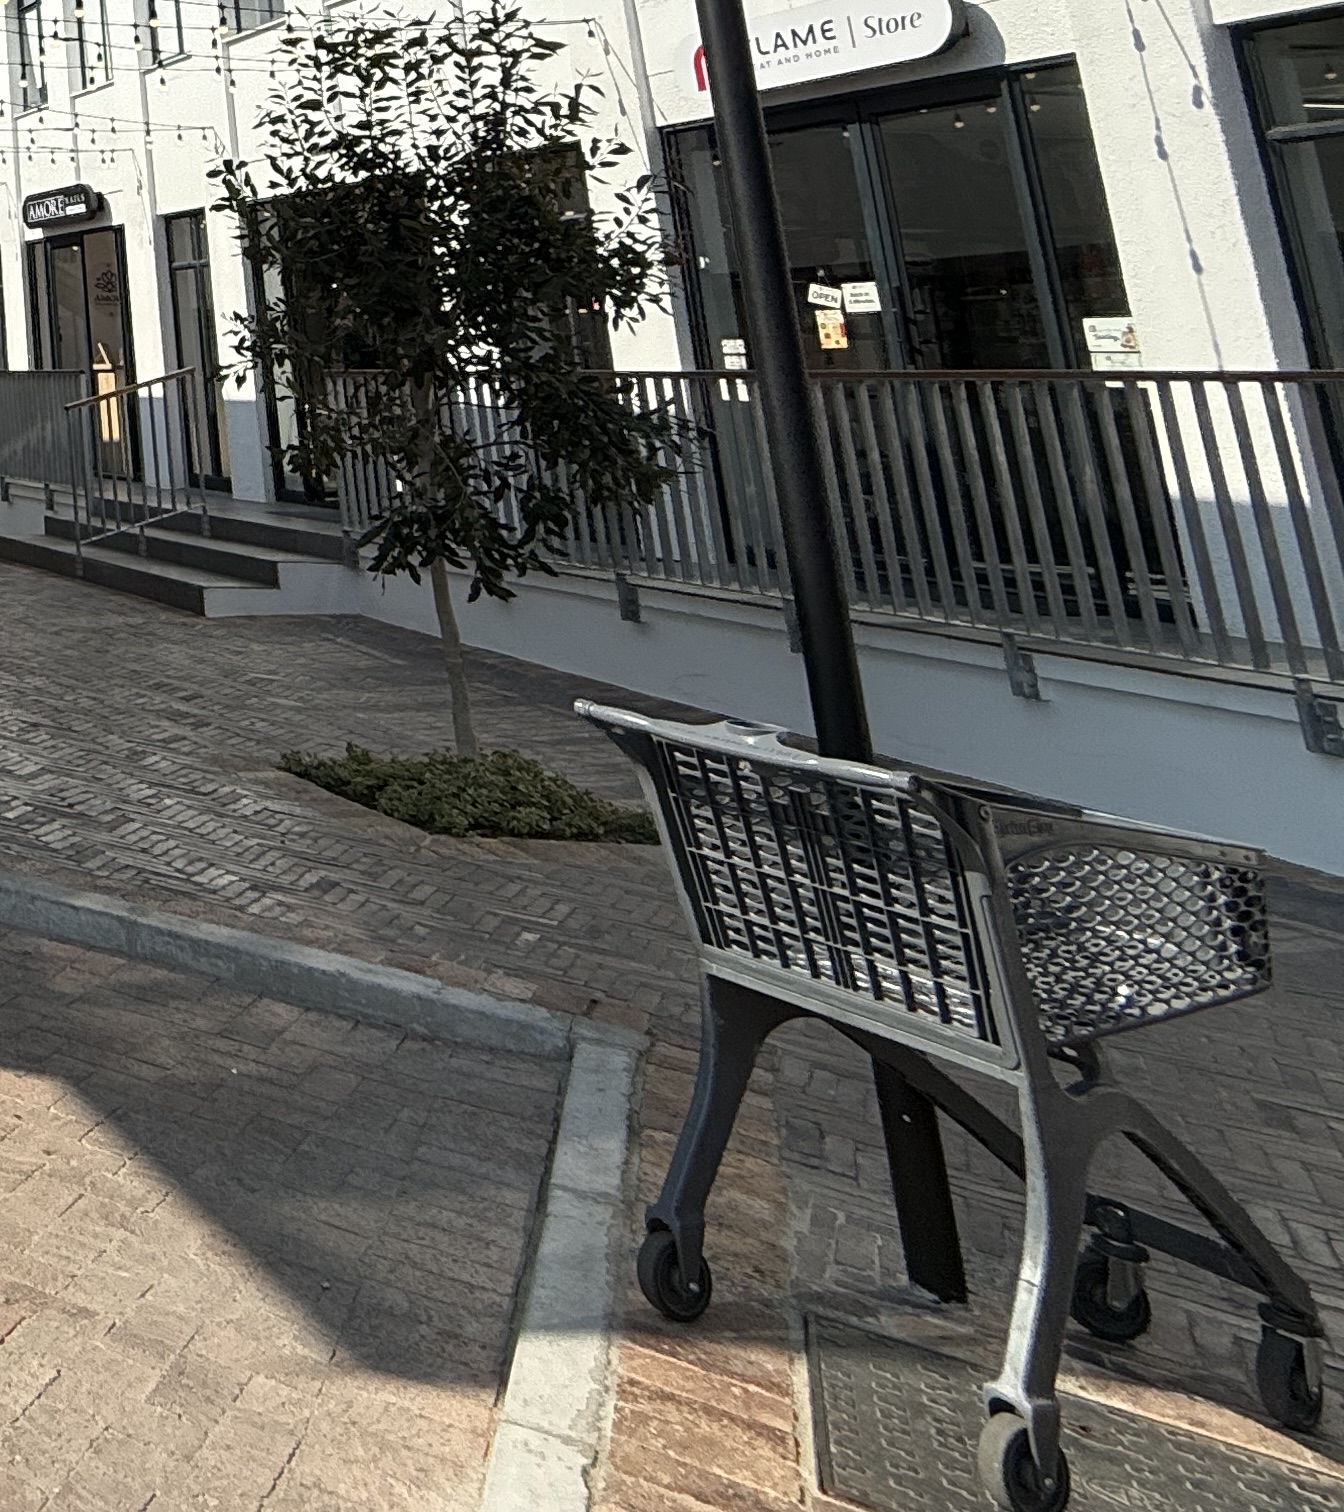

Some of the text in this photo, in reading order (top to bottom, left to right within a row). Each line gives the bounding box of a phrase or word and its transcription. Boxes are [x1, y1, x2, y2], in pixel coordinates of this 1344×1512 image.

[750, 11, 922, 56] LAME Store
[777, 54, 800, 65] AND
[805, 46, 840, 59] HOME
[29, 198, 65, 220] AMORE
[812, 291, 838, 304] OPEN
